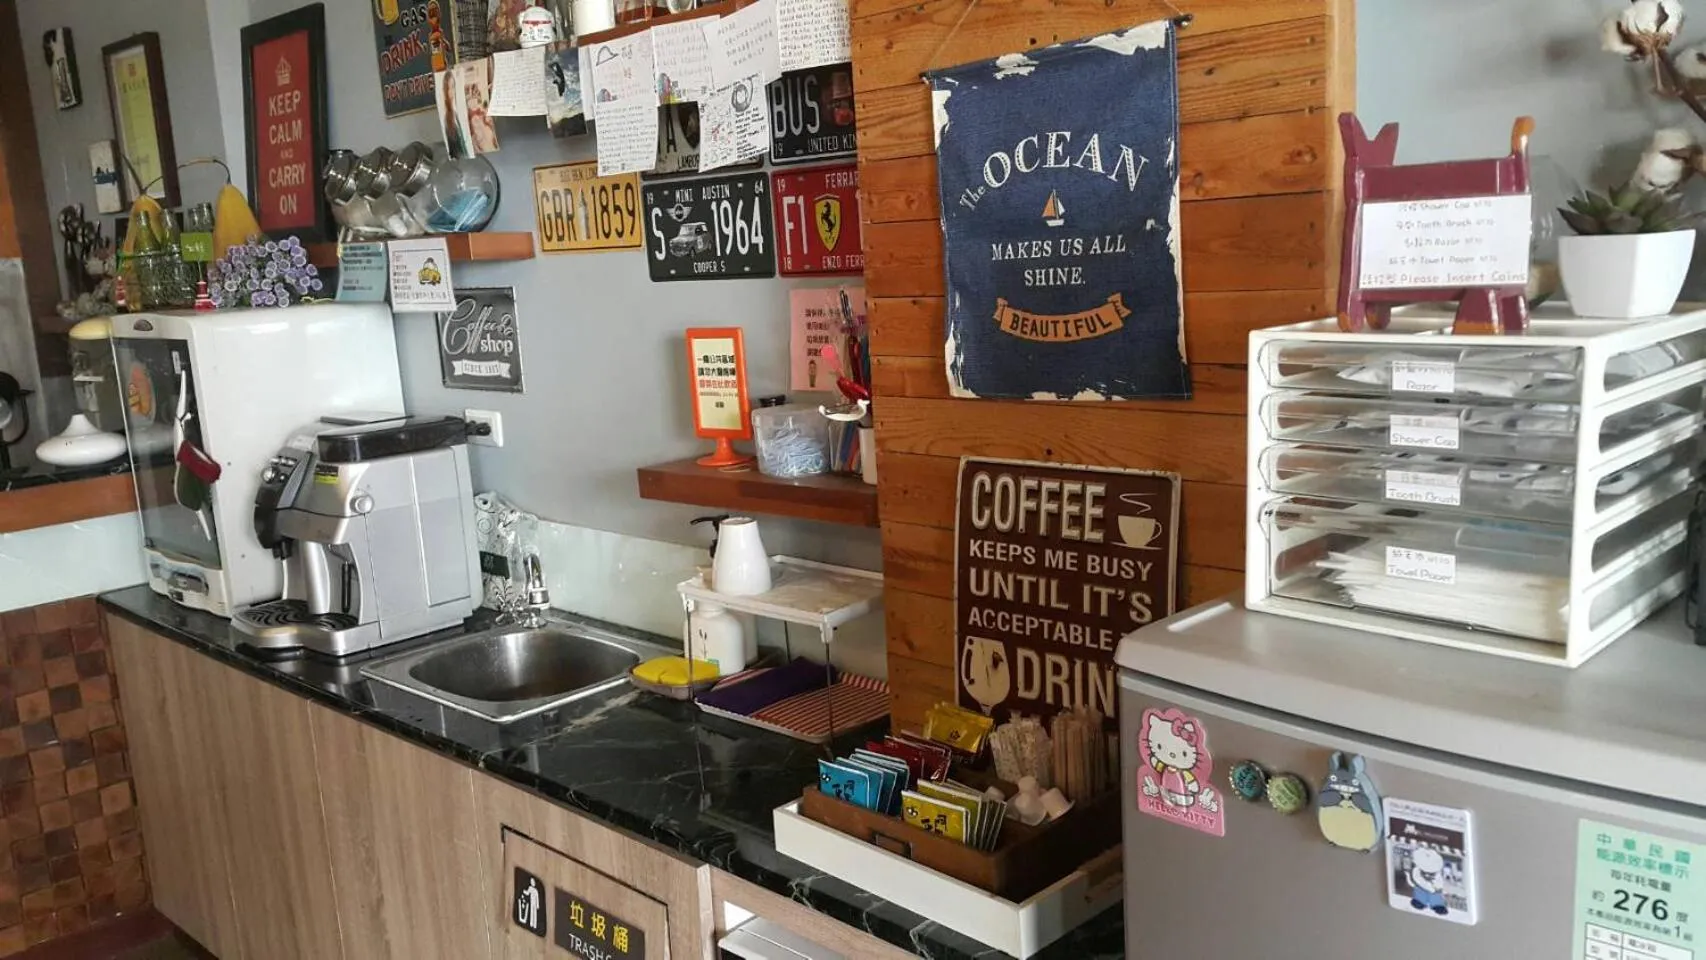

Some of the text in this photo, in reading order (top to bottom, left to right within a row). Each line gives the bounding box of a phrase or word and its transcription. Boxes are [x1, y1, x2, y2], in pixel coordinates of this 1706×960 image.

[400, 4, 427, 28] GAS
[268, 90, 301, 117] KEEP
[772, 74, 820, 139] BUS
[268, 119, 302, 144] CALM
[807, 135, 838, 153] UNITED
[280, 148, 293, 159] AND
[774, 143, 783, 156] 19
[268, 163, 306, 188] CARRY
[959, 131, 1149, 211] The OCEAN
[675, 183, 731, 203] MINI AUSTIN
[754, 179, 764, 195] 64
[777, 178, 786, 192] 19
[280, 193, 297, 216] ON
[540, 182, 635, 242] GBR 1859
[651, 196, 764, 260] S 1964
[782, 195, 808, 255] F1
[991, 234, 1126, 261] MAKES US ALL
[693, 260, 726, 274] COOPER S
[783, 257, 792, 270] 18
[822, 255, 842, 270] ENZO
[1024, 266, 1086, 287] SHINE.
[1400, 273, 1440, 283] Please
[1447, 272, 1485, 283] Insert
[1491, 270, 1527, 281] Coins
[443, 299, 500, 355] Coffee
[1009, 312, 1113, 338] BEAUTIFUL
[480, 333, 513, 357] shop
[1406, 380, 1439, 391] Razor
[1392, 432, 1457, 446] Shower Cap
[970, 471, 1107, 544] COFFEE
[1388, 488, 1459, 503] Tooth Brush
[969, 539, 1153, 582] KEEPS ME BUSY
[1387, 564, 1452, 581] Towel Paper
[969, 567, 1153, 623] UNTIL IT'S
[968, 606, 1113, 651] ACCEPTABLE
[1148, 798, 1216, 829] HELLO KITTY
[1612, 889, 1669, 921] 276
[570, 900, 629, 953] 垃圾桶
[569, 933, 604, 960] TRASH
